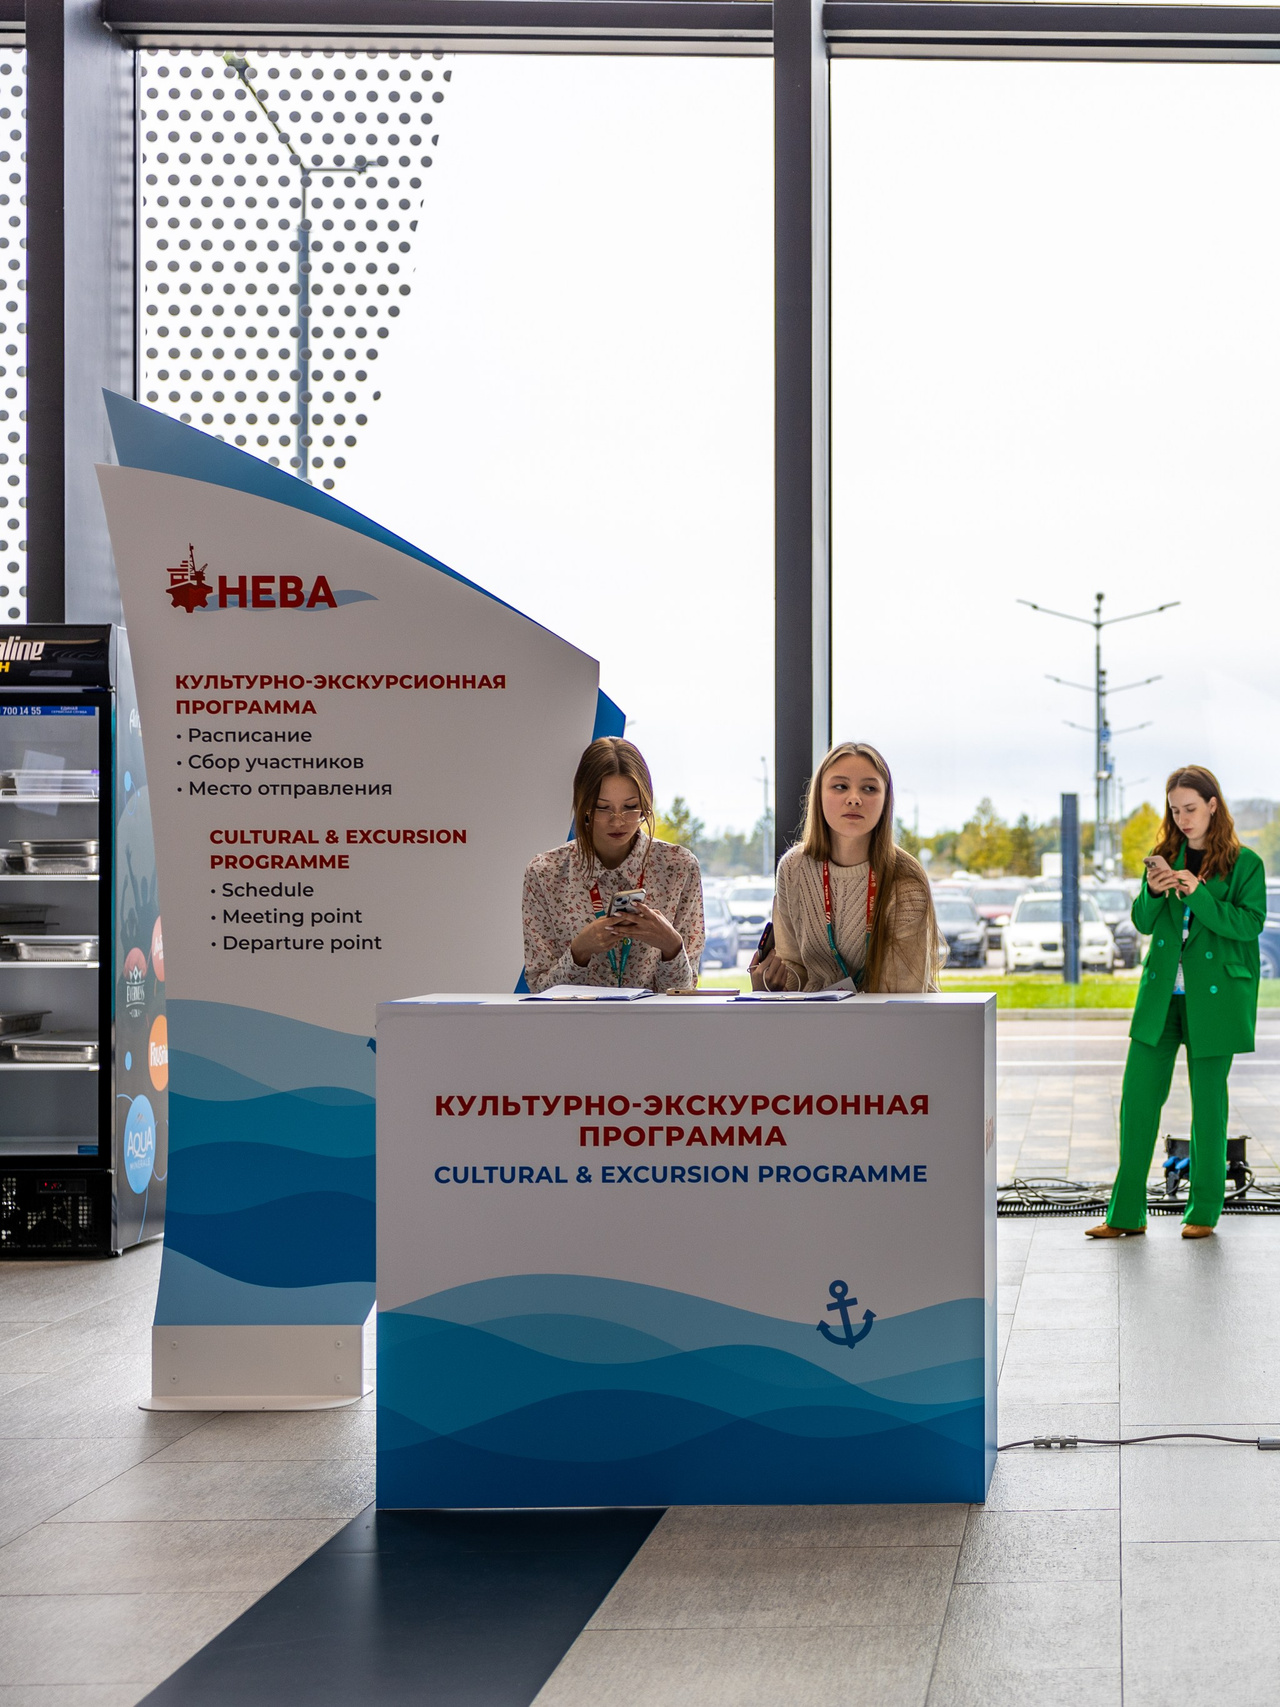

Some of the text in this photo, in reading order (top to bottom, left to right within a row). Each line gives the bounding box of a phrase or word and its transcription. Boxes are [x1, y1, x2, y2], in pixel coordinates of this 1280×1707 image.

[218, 576, 337, 608] НЕВА
[176, 675, 505, 689] КУЛЬТУРНО-ЭКСКУРСИОННАЯ
[2, 707, 42, 716] 700 14 55
[177, 700, 317, 714] ПРОГРАММА
[189, 728, 312, 742] Расписание
[189, 754, 363, 772] Сбор участников
[190, 781, 391, 799] Место отправления
[210, 830, 466, 844] CULTURAL & EXCURSION
[211, 855, 349, 869] PROGRAMME
[223, 882, 314, 897] Schedule
[224, 908, 362, 927] Meeting point
[224, 934, 382, 953] Departure point
[436, 1095, 928, 1116] КУЛЬТУРНО-ЭКСКУРСИОННАЯ
[127, 1126, 153, 1158] AQUA
[580, 1126, 787, 1146] ПРОГРАММА
[435, 1165, 927, 1183] CULTURAL & EXCURSION PROGRAMME
